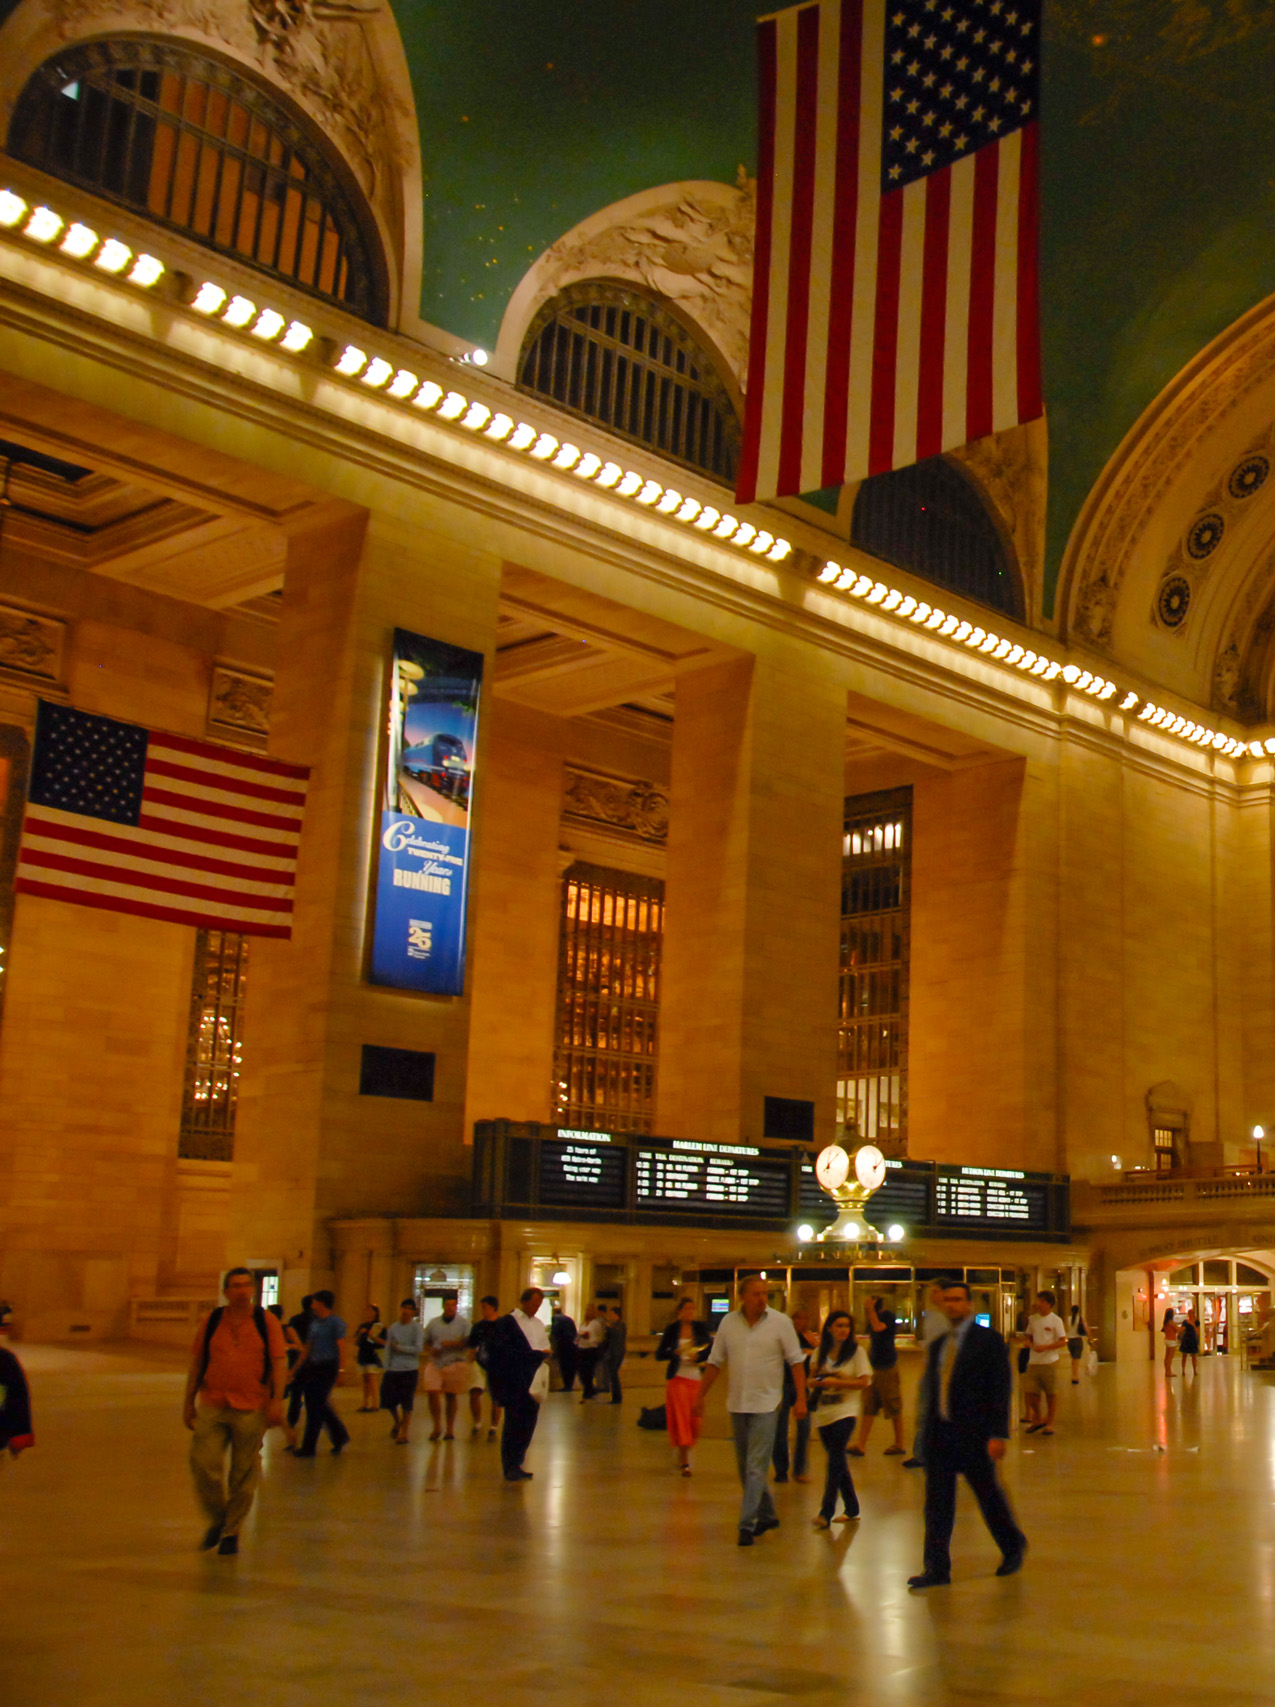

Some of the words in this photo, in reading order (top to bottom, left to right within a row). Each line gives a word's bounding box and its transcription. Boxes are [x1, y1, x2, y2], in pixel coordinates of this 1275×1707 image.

[382, 820, 450, 854] Celebrating
[418, 860, 453, 876] Years
[392, 868, 452, 896] RUNNING
[557, 1129, 612, 1142] INFORMATION
[672, 1140, 702, 1151] HARLEM
[702, 1143, 718, 1153] LINE
[718, 1145, 760, 1156] DEPARTURES
